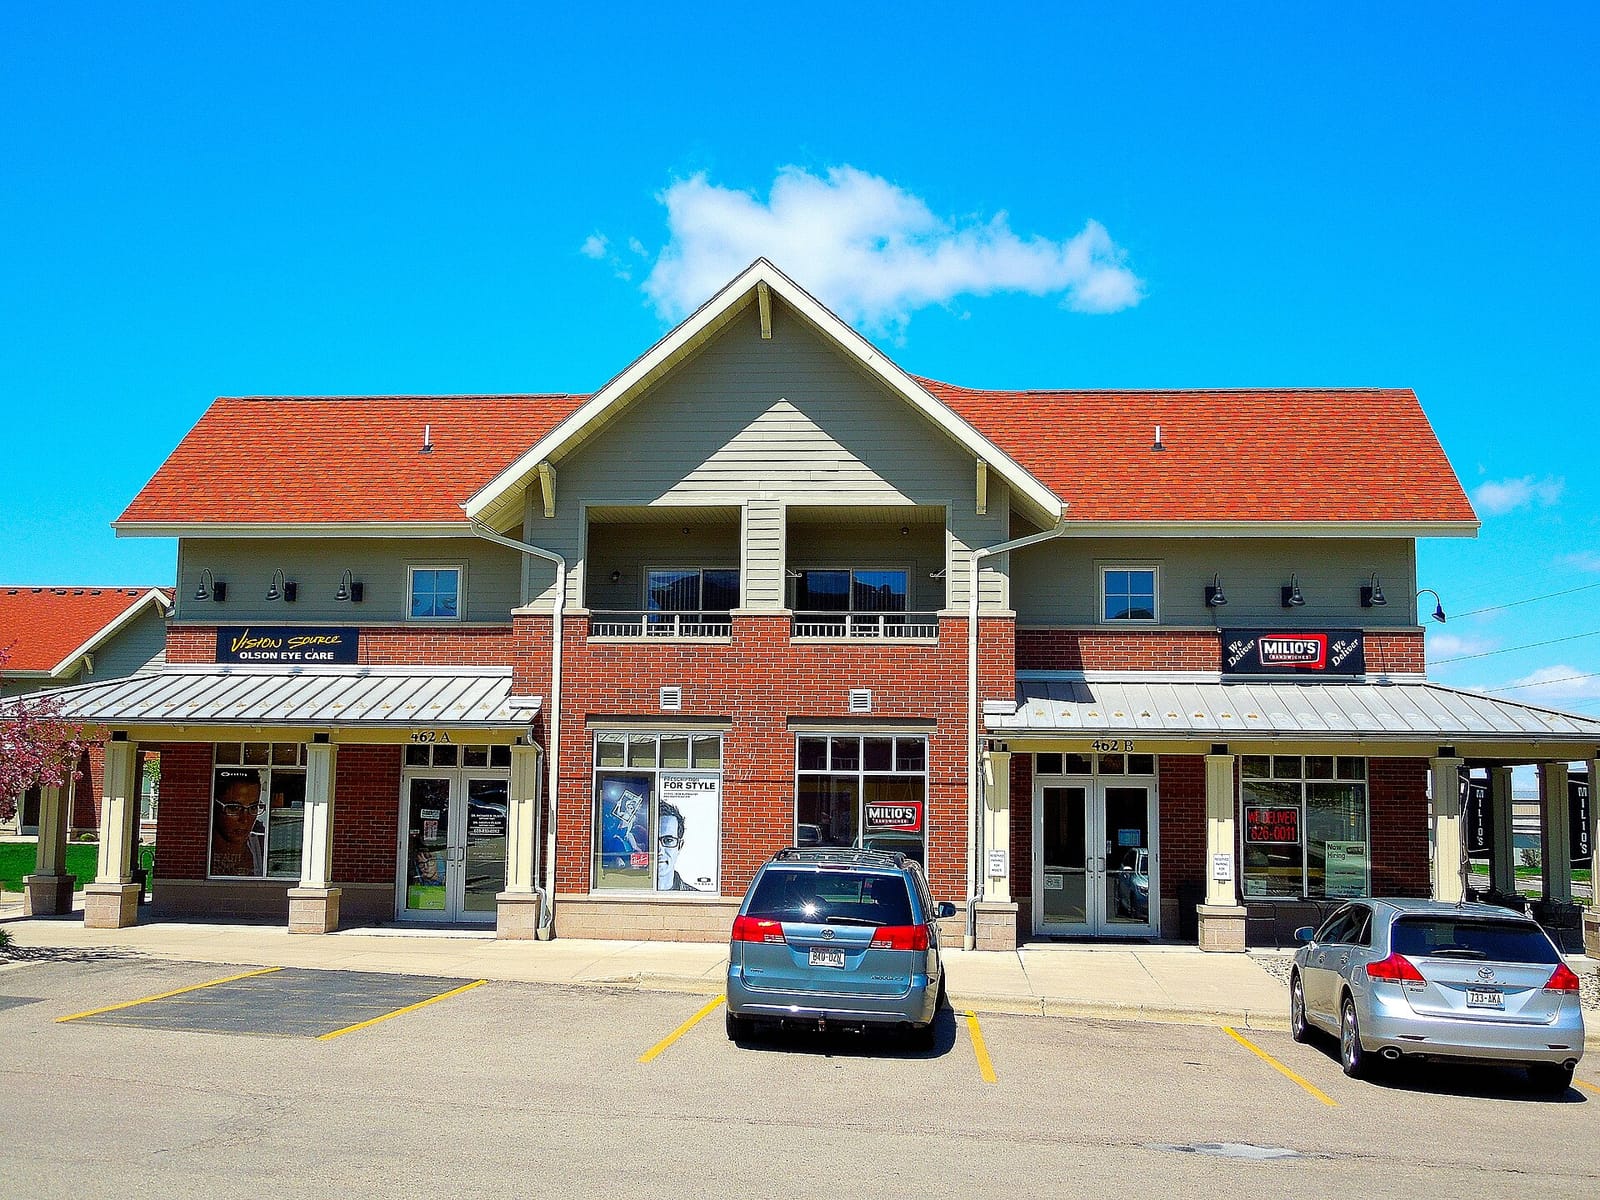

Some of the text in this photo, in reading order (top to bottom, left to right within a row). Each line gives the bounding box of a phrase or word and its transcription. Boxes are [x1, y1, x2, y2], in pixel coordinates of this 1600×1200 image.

[1227, 639, 1255, 667] Deliver
[1228, 640, 1243, 654] We
[1264, 642, 1316, 654] MILIO'S
[1331, 640, 1346, 654] We
[1331, 639, 1359, 667] Deliver
[240, 652, 334, 660] OLSON EYE CARE
[411, 731, 451, 743] 462 A
[1092, 740, 1134, 752] 462 B
[664, 782, 716, 790] FOR STYLE
[869, 807, 913, 819] MILIO'S
[1262, 811, 1297, 825] DELIVER
[1476, 789, 1485, 846] MILIO'S
[1577, 786, 1588, 854] MILIO'S
